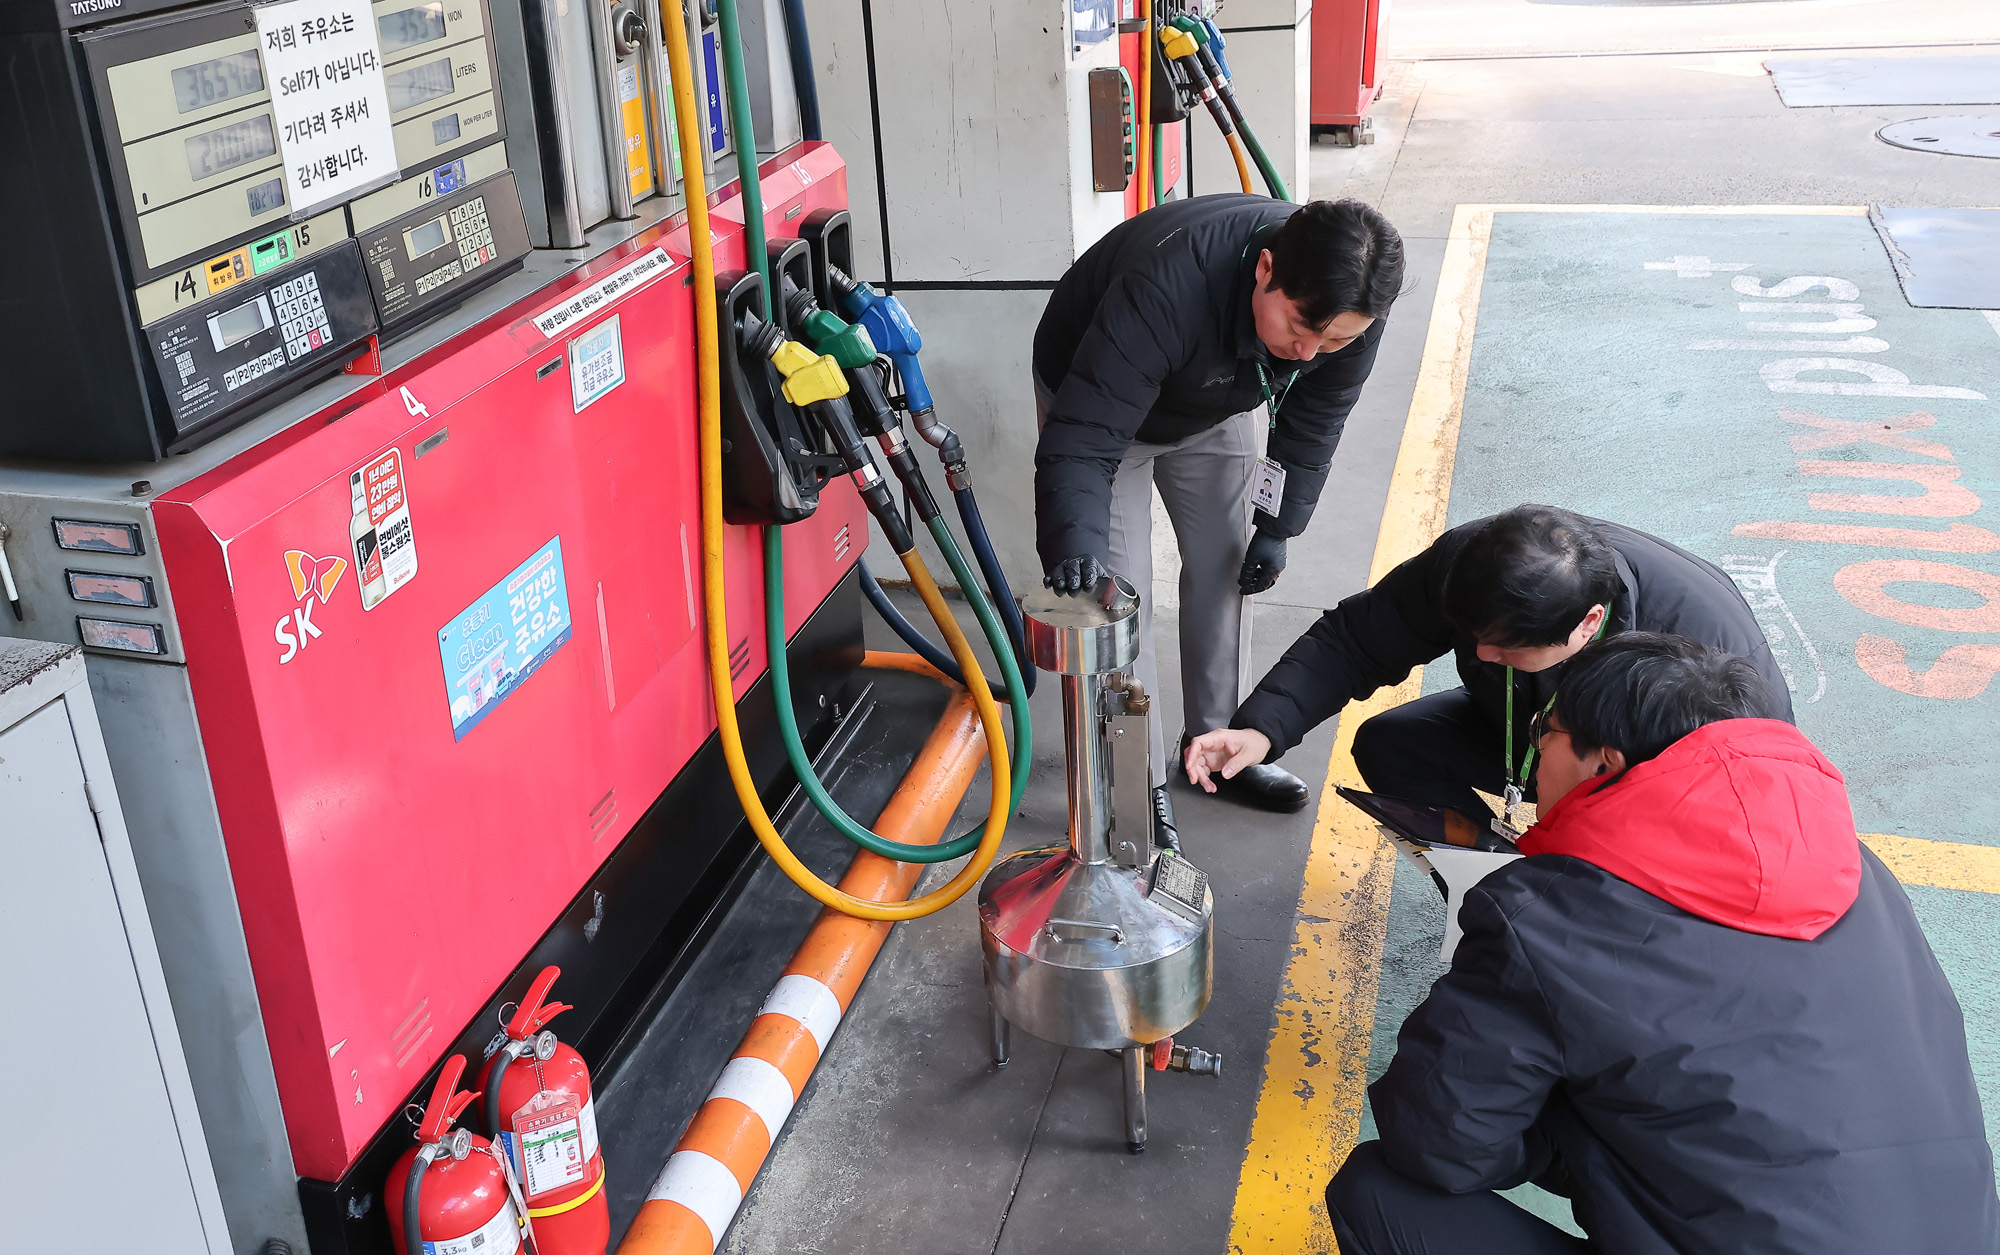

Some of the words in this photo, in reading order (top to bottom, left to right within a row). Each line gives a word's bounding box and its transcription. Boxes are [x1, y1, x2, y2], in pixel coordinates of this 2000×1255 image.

[70, 0, 121, 16] TATSUNO
[447, 10, 462, 22] WON
[266, 25, 297, 52] 저희
[301, 12, 355, 44] 주유소는
[280, 66, 320, 96] Self가
[324, 49, 379, 84] 아닙니다.
[456, 63, 477, 78] LITERS
[285, 111, 327, 144] 기다려
[331, 97, 370, 129] 주셔서
[463, 117, 474, 126] WON
[482, 110, 492, 119] LITER
[627, 133, 641, 153] 발유
[297, 144, 368, 189] 감사합니다.
[791, 161, 812, 185] 16
[419, 176, 431, 198] 16
[452, 211, 457, 222] 7
[461, 207, 466, 218] 8
[469, 204, 474, 214] 9
[294, 225, 310, 248] 15
[457, 227, 462, 237] 4
[465, 223, 470, 234] 5
[473, 220, 478, 230] 6
[461, 244, 465, 253] 1
[469, 239, 474, 249] 2
[477, 235, 482, 246] 3
[465, 259, 470, 269] 0
[480, 250, 487, 260] C
[489, 247, 494, 256] L
[175, 270, 196, 302] 14
[274, 290, 280, 302] 7
[285, 285, 292, 297] 8
[297, 281, 303, 292] 9
[417, 282, 425, 292] P1
[426, 277, 434, 288] P2
[435, 272, 444, 283] P3
[442, 268, 451, 278] P4
[280, 308, 286, 320] 4
[291, 304, 297, 315] 5
[302, 299, 308, 310] 6
[553, 308, 573, 325] 진입시
[569, 301, 583, 315] 다른
[285, 326, 291, 338] 1
[296, 321, 303, 333] 2
[307, 316, 313, 328] 3
[1686, 275, 1988, 401] plus
[290, 344, 297, 356] 0
[311, 333, 319, 345] C
[322, 329, 329, 340] L
[226, 375, 236, 387] P1
[238, 368, 249, 381] P2
[250, 363, 260, 375] P3
[262, 357, 272, 370] P4
[273, 351, 283, 364] P5
[581, 350, 613, 380] 유가보조금
[583, 377, 595, 393] 지급
[597, 366, 614, 385] 주유소
[399, 386, 430, 418] 4
[369, 473, 398, 504] 23만원
[371, 502, 386, 522] 연비
[386, 490, 402, 512] 절약
[1731, 408, 2000, 700] solux
[509, 565, 557, 627] 건강한
[274, 595, 324, 664] SK
[461, 602, 491, 639] 유증기
[515, 600, 562, 655] 주유소
[456, 623, 504, 673] Clean
